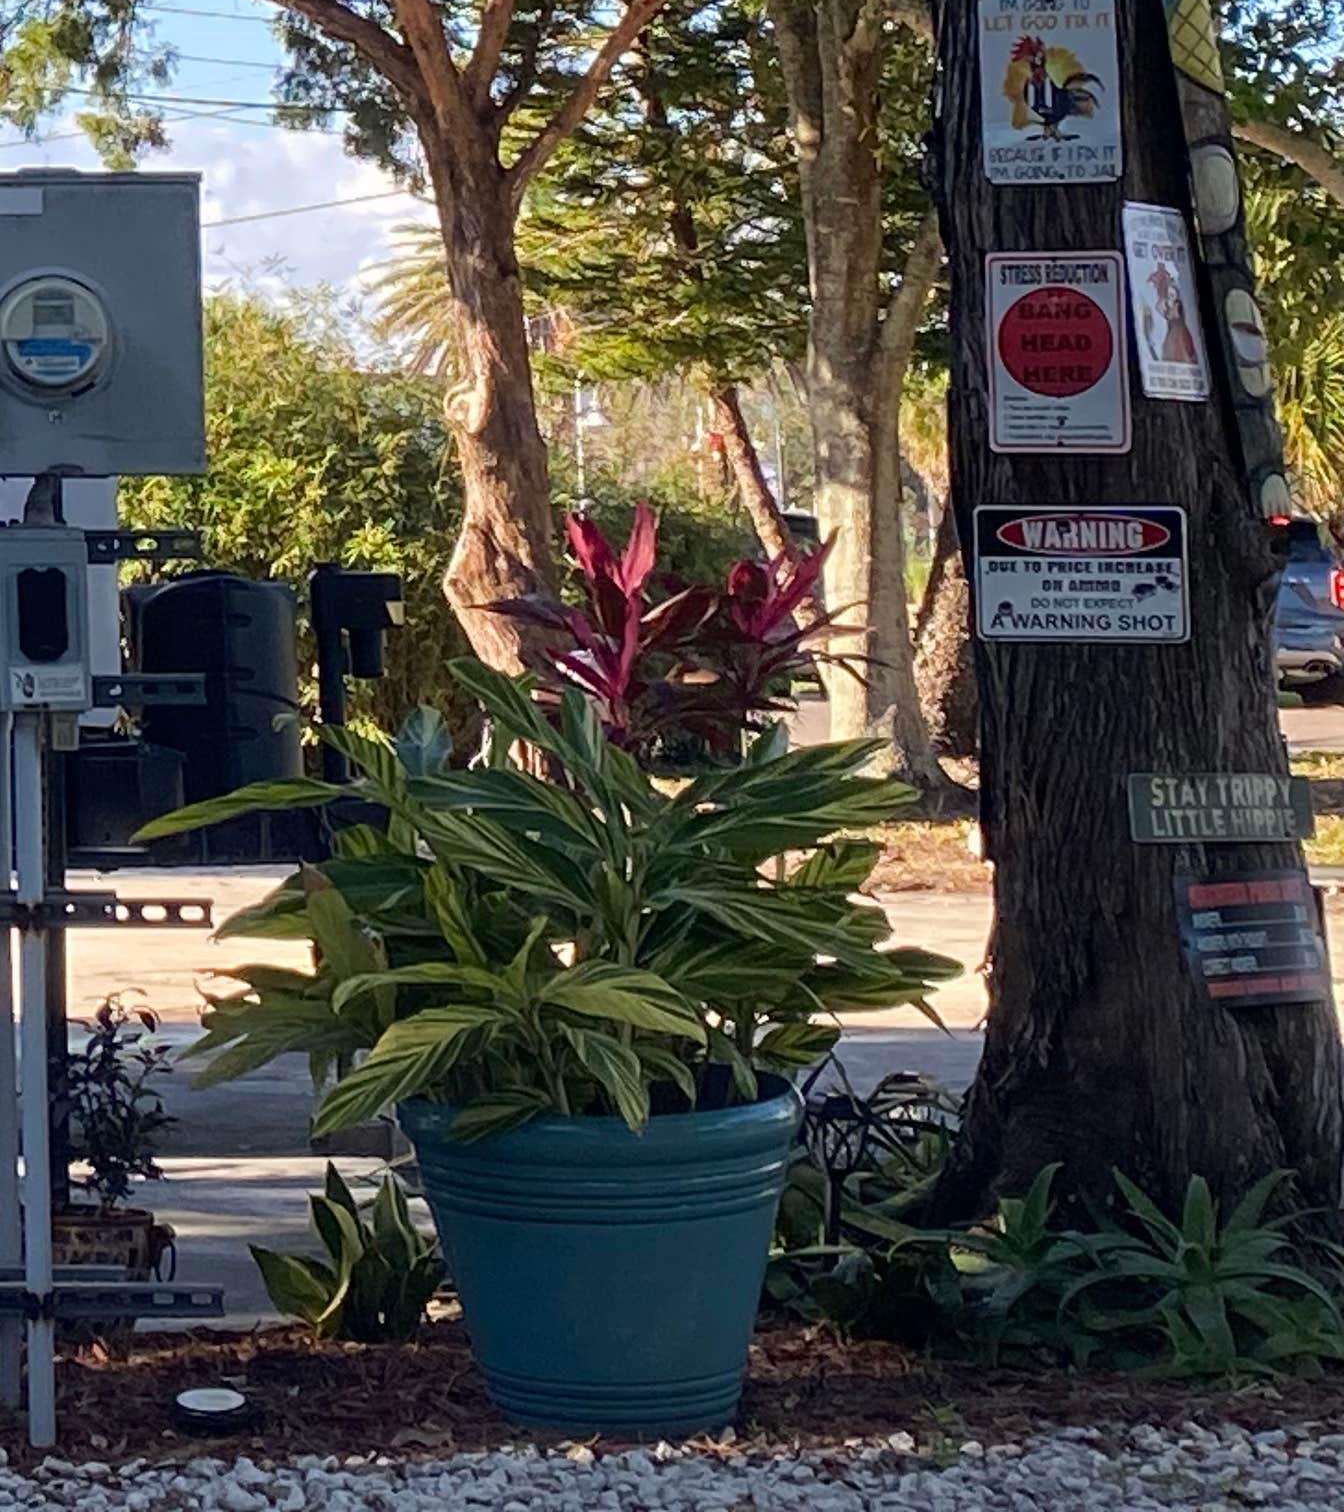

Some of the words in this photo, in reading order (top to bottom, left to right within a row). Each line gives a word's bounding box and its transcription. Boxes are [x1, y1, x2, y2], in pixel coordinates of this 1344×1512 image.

[984, 14, 1012, 31] LET
[1021, 14, 1058, 30] GOD
[1096, 12, 1112, 28] IT
[1067, 165, 1085, 178] TO
[1000, 264, 1042, 285] STRESS
[1044, 263, 1109, 284] REDUCTION
[1017, 302, 1092, 320] BANG
[1020, 334, 1093, 352] HEAD
[1023, 365, 1093, 384] HERE
[1021, 519, 1144, 550] WARNING
[988, 560, 1017, 574] DUE
[1024, 560, 1042, 574] TO
[1048, 560, 1093, 574] PRICE
[1098, 561, 1174, 575] INCREASE
[1069, 579, 1122, 593] AMMO
[1031, 597, 1051, 609] DO
[1053, 597, 1081, 609] NOT
[1084, 597, 1134, 609] EXPECT
[991, 613, 1004, 629] A
[1011, 613, 1112, 630] WARNING
[1118, 614, 1177, 631] SHOT
[1151, 777, 1209, 808] STAY
[1216, 776, 1293, 807] TRIPPY
[1151, 809, 1226, 837] LITTLE
[1230, 808, 1297, 837] HIPPIE
